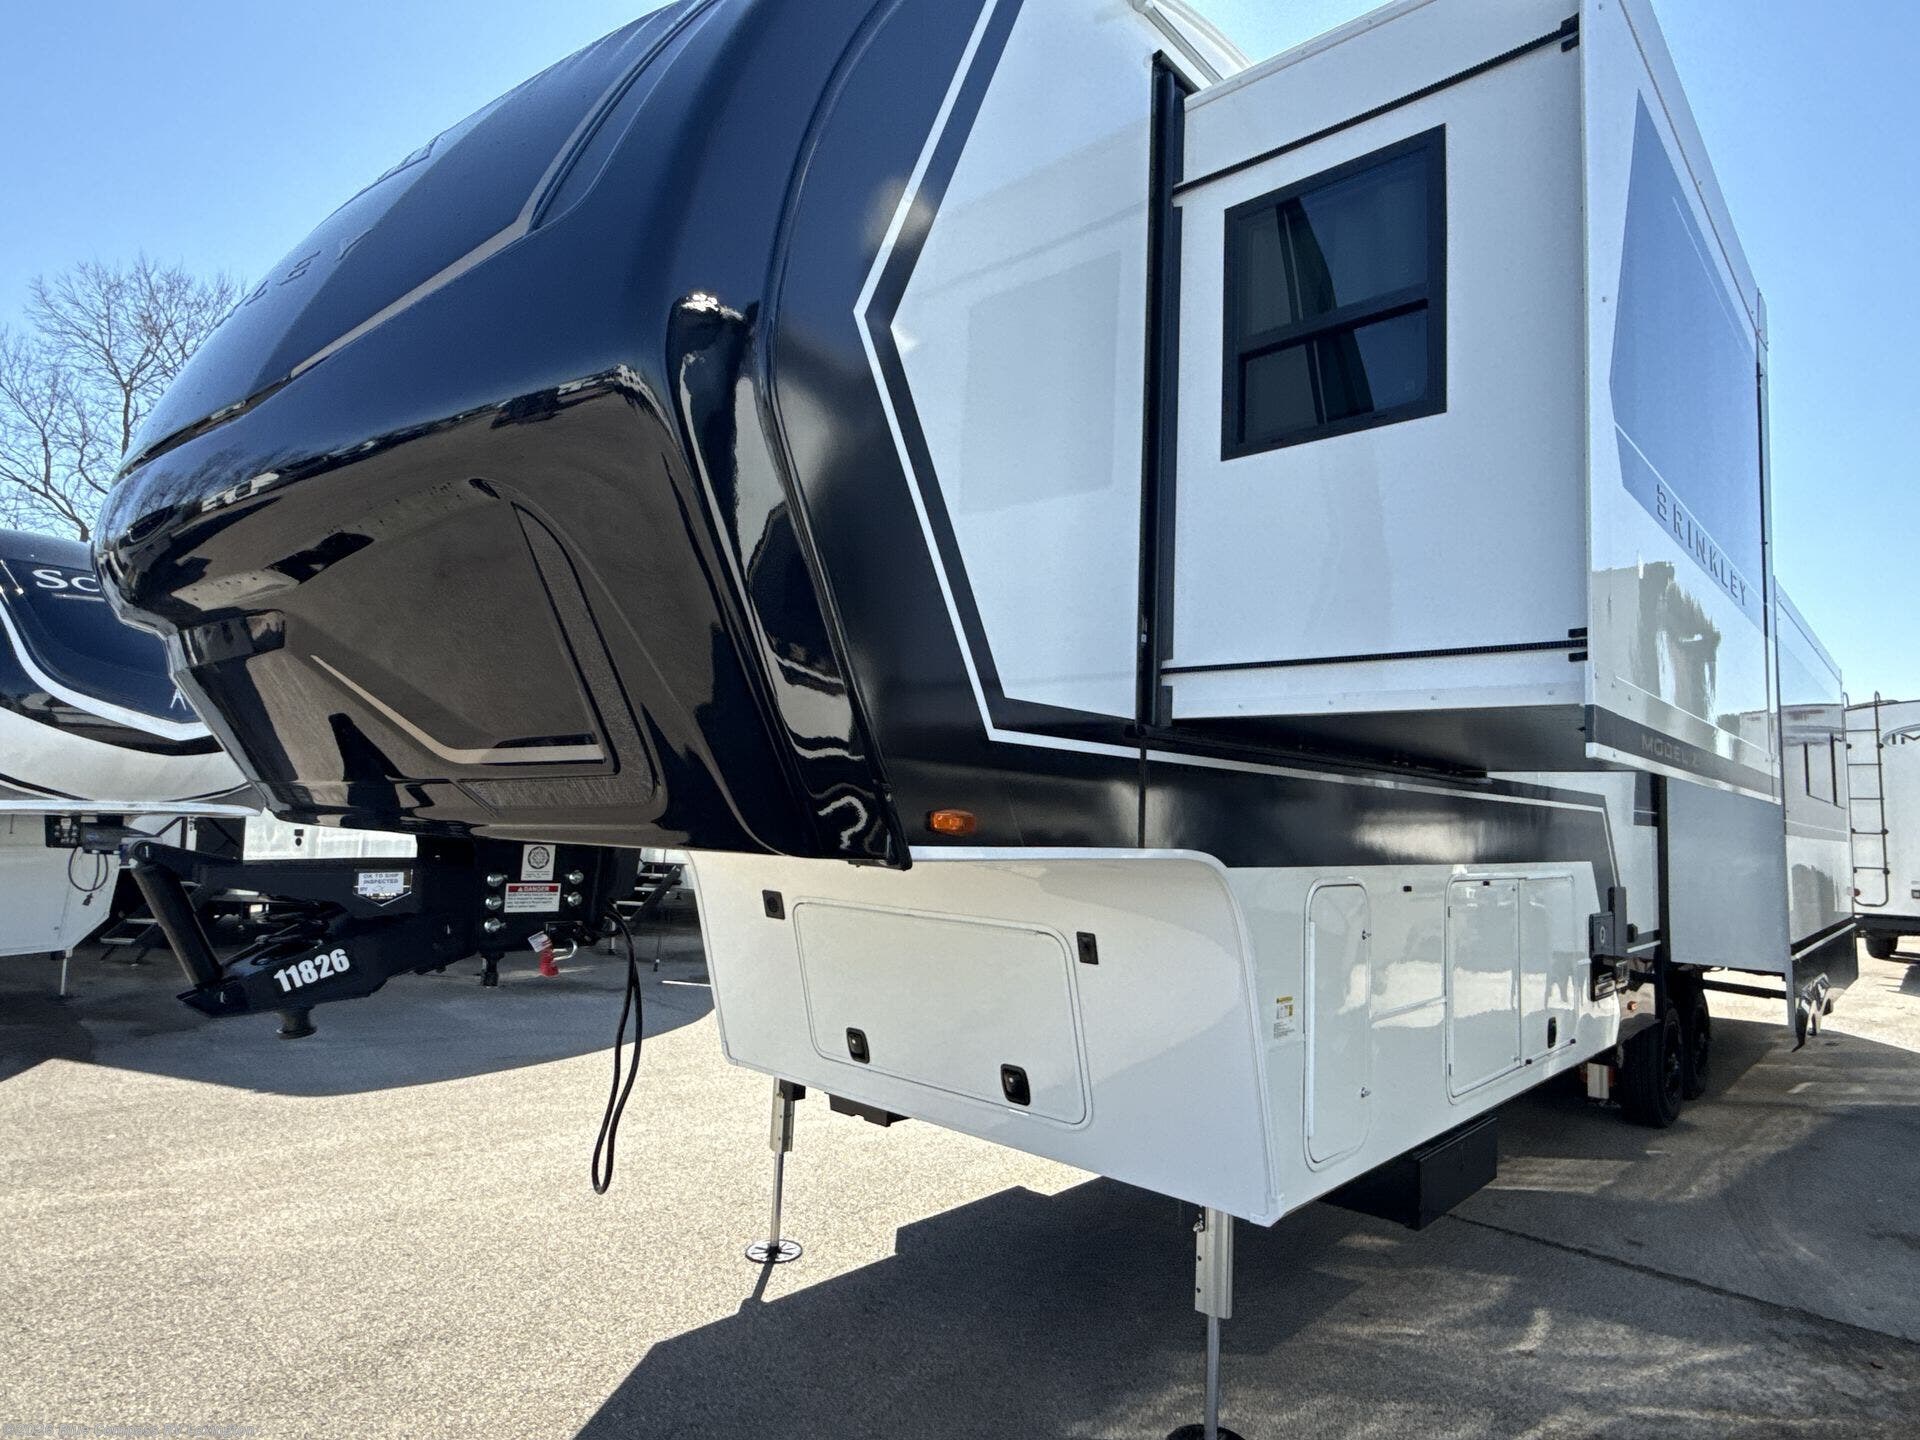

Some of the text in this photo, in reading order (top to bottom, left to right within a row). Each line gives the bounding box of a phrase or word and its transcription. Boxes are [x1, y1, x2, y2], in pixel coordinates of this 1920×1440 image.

[1656, 483, 1746, 606] BRINKLEY
[1641, 734, 1689, 764] MODEL
[273, 948, 350, 992] 11826
